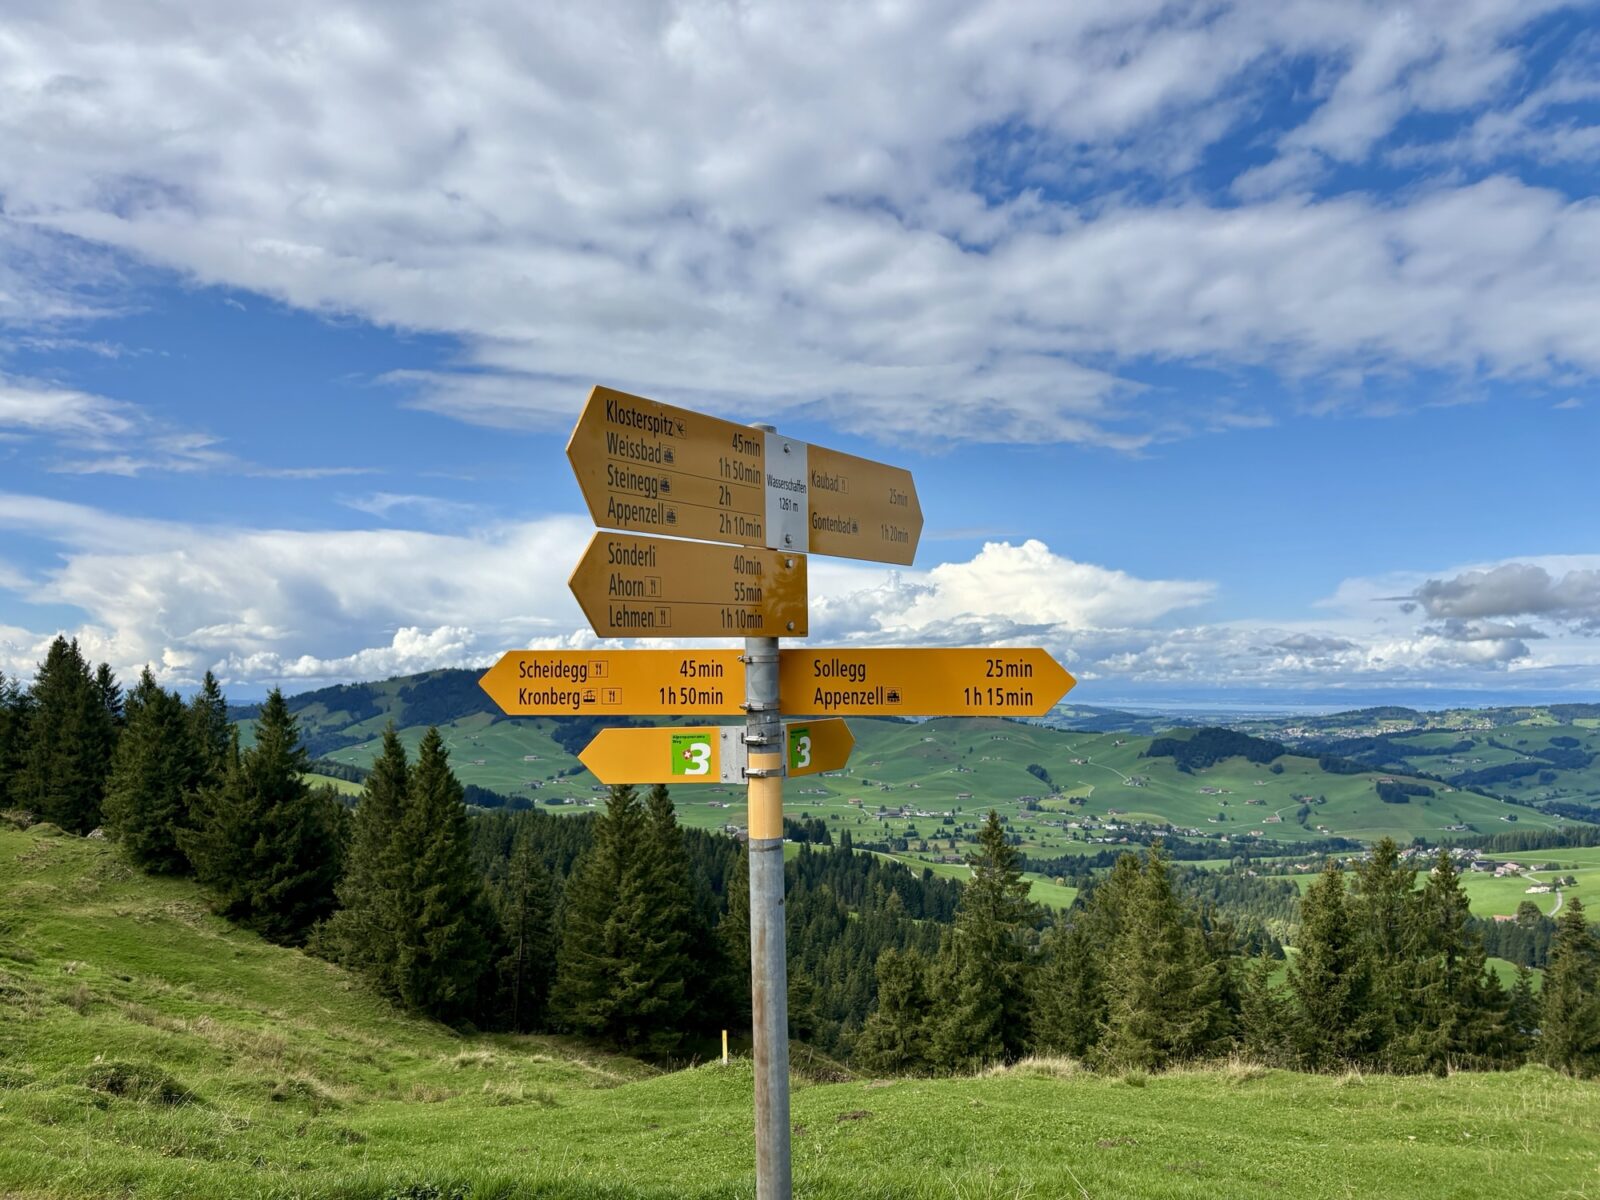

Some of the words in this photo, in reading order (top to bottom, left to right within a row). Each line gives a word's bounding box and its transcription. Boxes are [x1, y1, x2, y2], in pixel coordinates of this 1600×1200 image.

[606, 399, 674, 438] Klosterspitz
[606, 432, 661, 464] Weissbad
[607, 464, 658, 499] Steinegg
[811, 470, 839, 492] Kaubad
[607, 496, 664, 526] Appenzell
[779, 497, 792, 511] 1261
[792, 502, 799, 512] m
[812, 512, 851, 534] Gontenbad
[608, 542, 656, 567] Sönderli
[608, 573, 644, 597] Ahorn
[609, 605, 654, 628] Lehmen
[519, 660, 587, 683] Scheidegg
[814, 659, 866, 682] Sollegg
[519, 687, 580, 710] Kronberg
[814, 686, 884, 710] Appenzell
[684, 742, 711, 775] 3
[797, 736, 811, 768] 3
